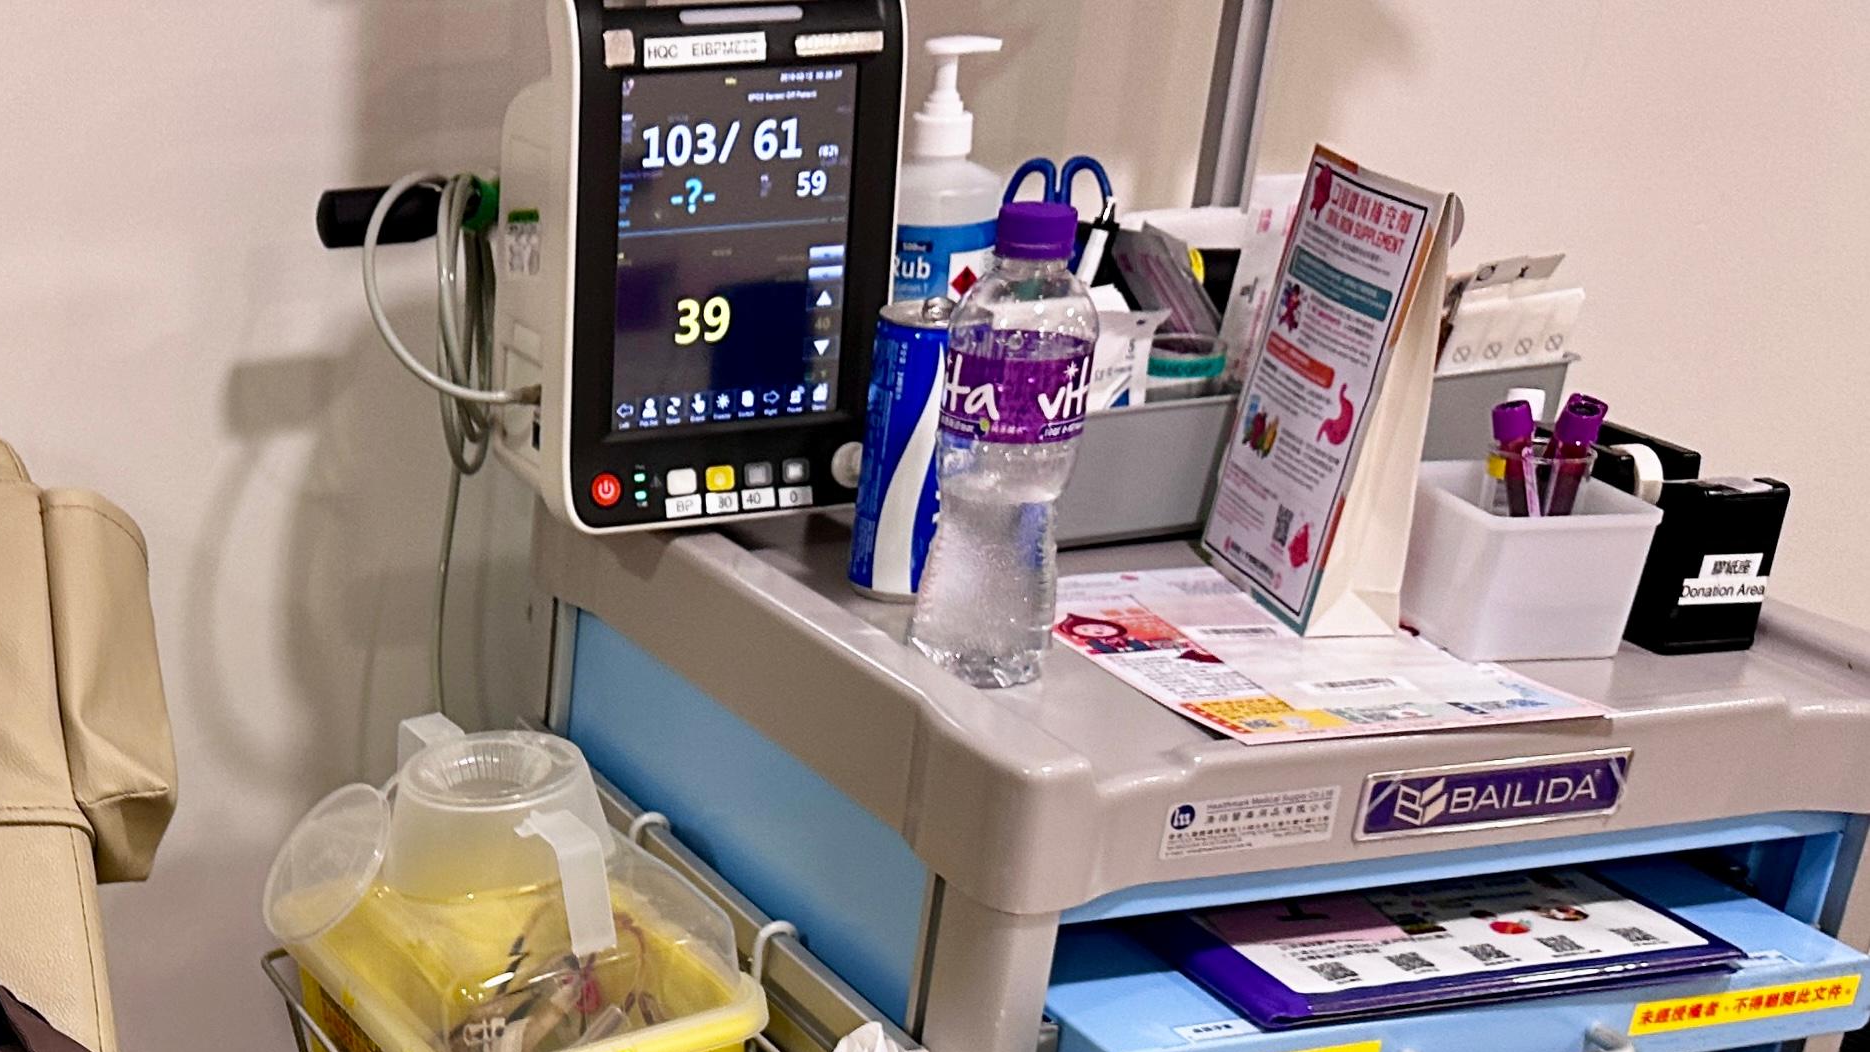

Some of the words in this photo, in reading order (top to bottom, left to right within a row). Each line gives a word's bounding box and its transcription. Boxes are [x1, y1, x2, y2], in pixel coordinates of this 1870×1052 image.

[648, 44, 678, 59] HQC
[754, 117, 802, 161] 61
[796, 170, 827, 197] 59
[674, 296, 730, 345] 39
[942, 354, 1000, 420] ita
[1038, 356, 1089, 419] vit
[746, 491, 761, 505] 40
[790, 491, 798, 503] 0
[1682, 585, 1734, 597] Donation
[1737, 584, 1765, 596] Area
[1449, 774, 1598, 814] BAILIDA
